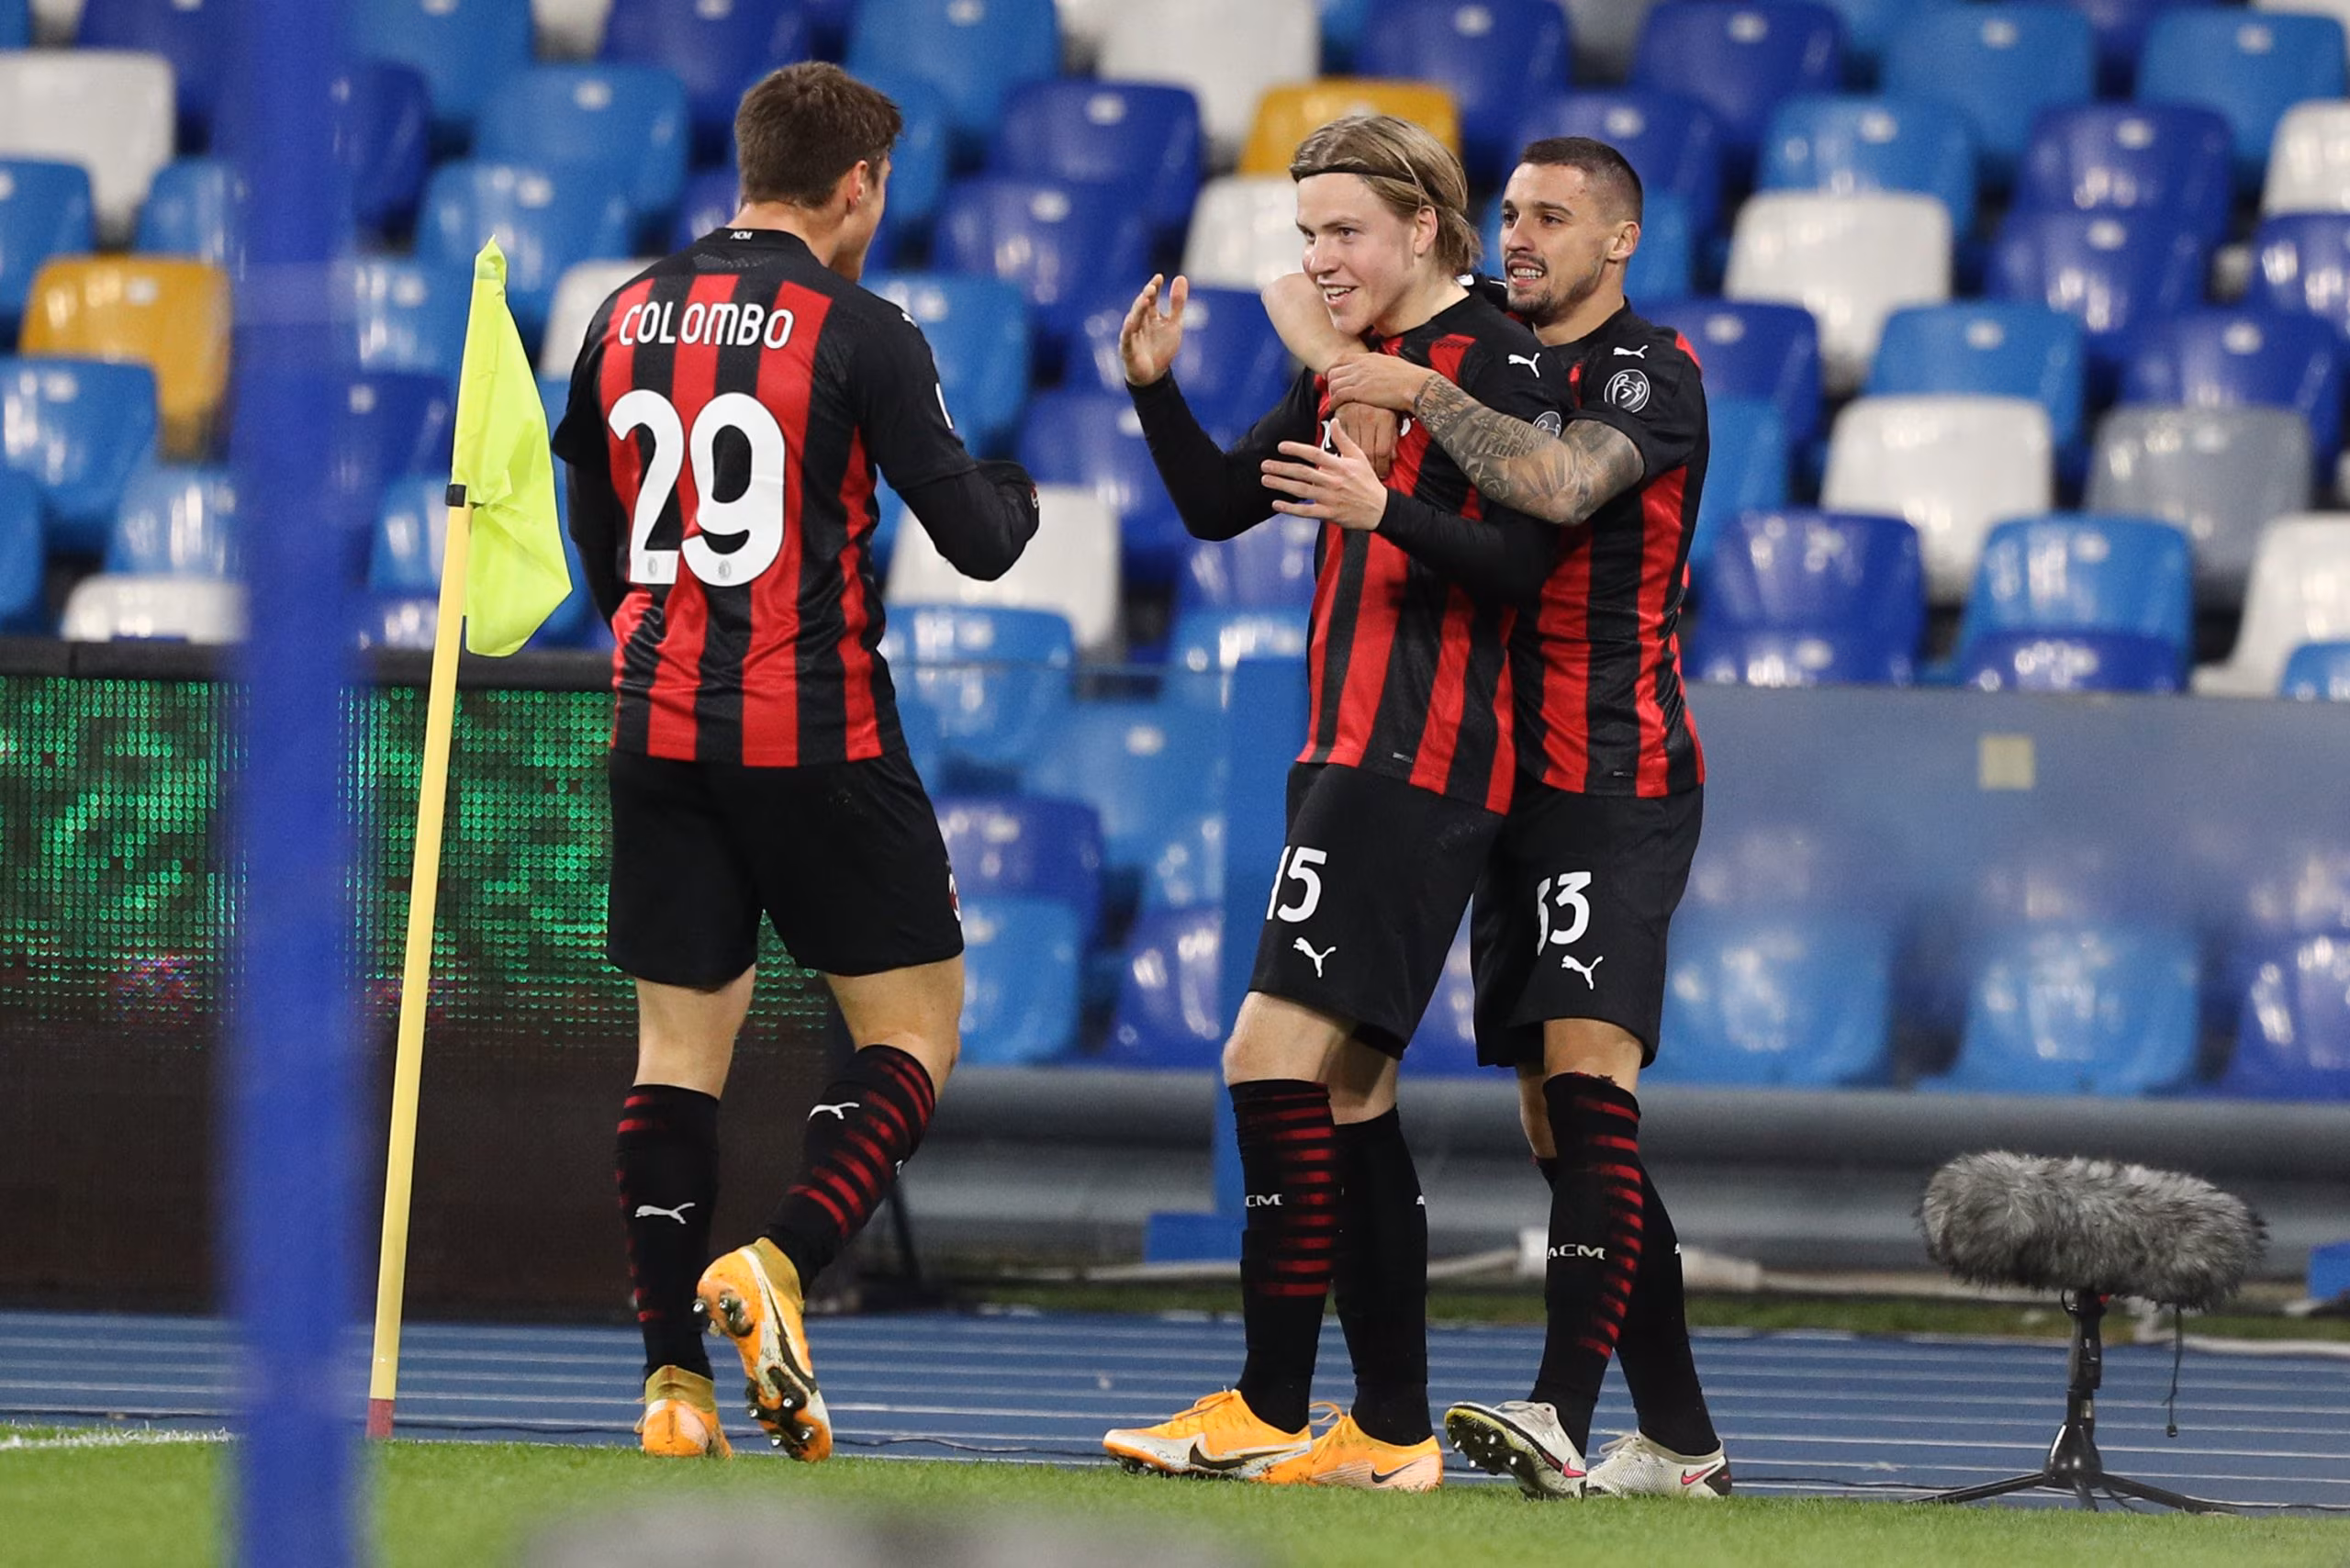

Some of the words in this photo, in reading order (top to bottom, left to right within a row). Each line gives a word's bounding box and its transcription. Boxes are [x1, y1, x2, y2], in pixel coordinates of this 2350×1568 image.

[729, 230, 753, 241] ACM
[619, 301, 794, 350] COLOMBO
[608, 389, 785, 587] 29
[1245, 1193, 1283, 1207] CM
[1548, 1243, 1606, 1260] ACM
